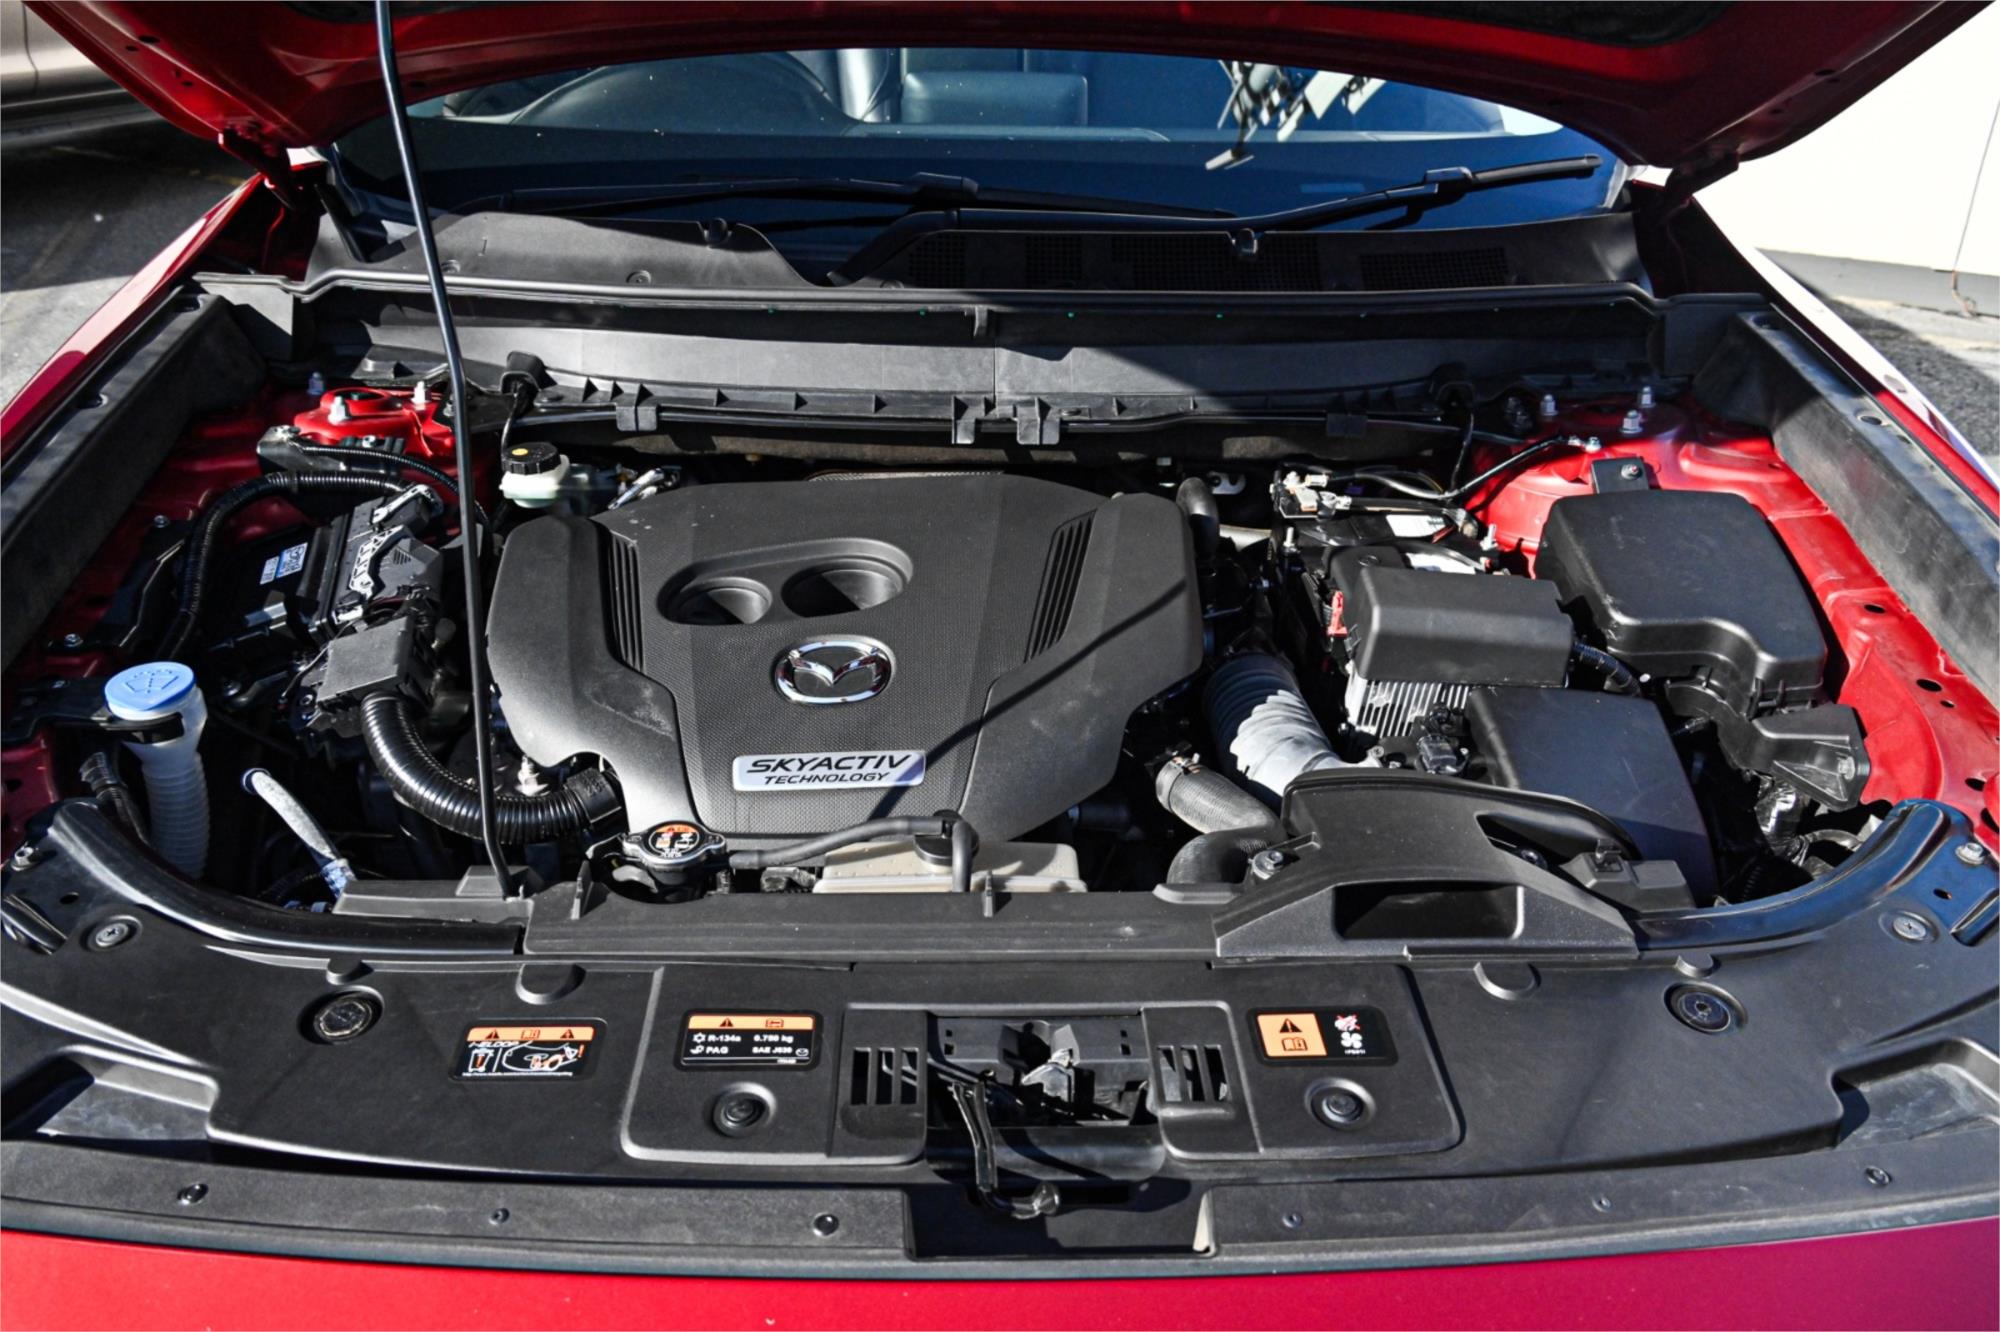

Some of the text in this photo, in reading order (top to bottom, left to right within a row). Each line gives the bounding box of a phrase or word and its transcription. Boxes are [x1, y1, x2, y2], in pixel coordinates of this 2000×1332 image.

[747, 754, 912, 773] SKYACTIV
[764, 772, 890, 785] TECHNOLOGY
[705, 1046, 729, 1054] PAG
